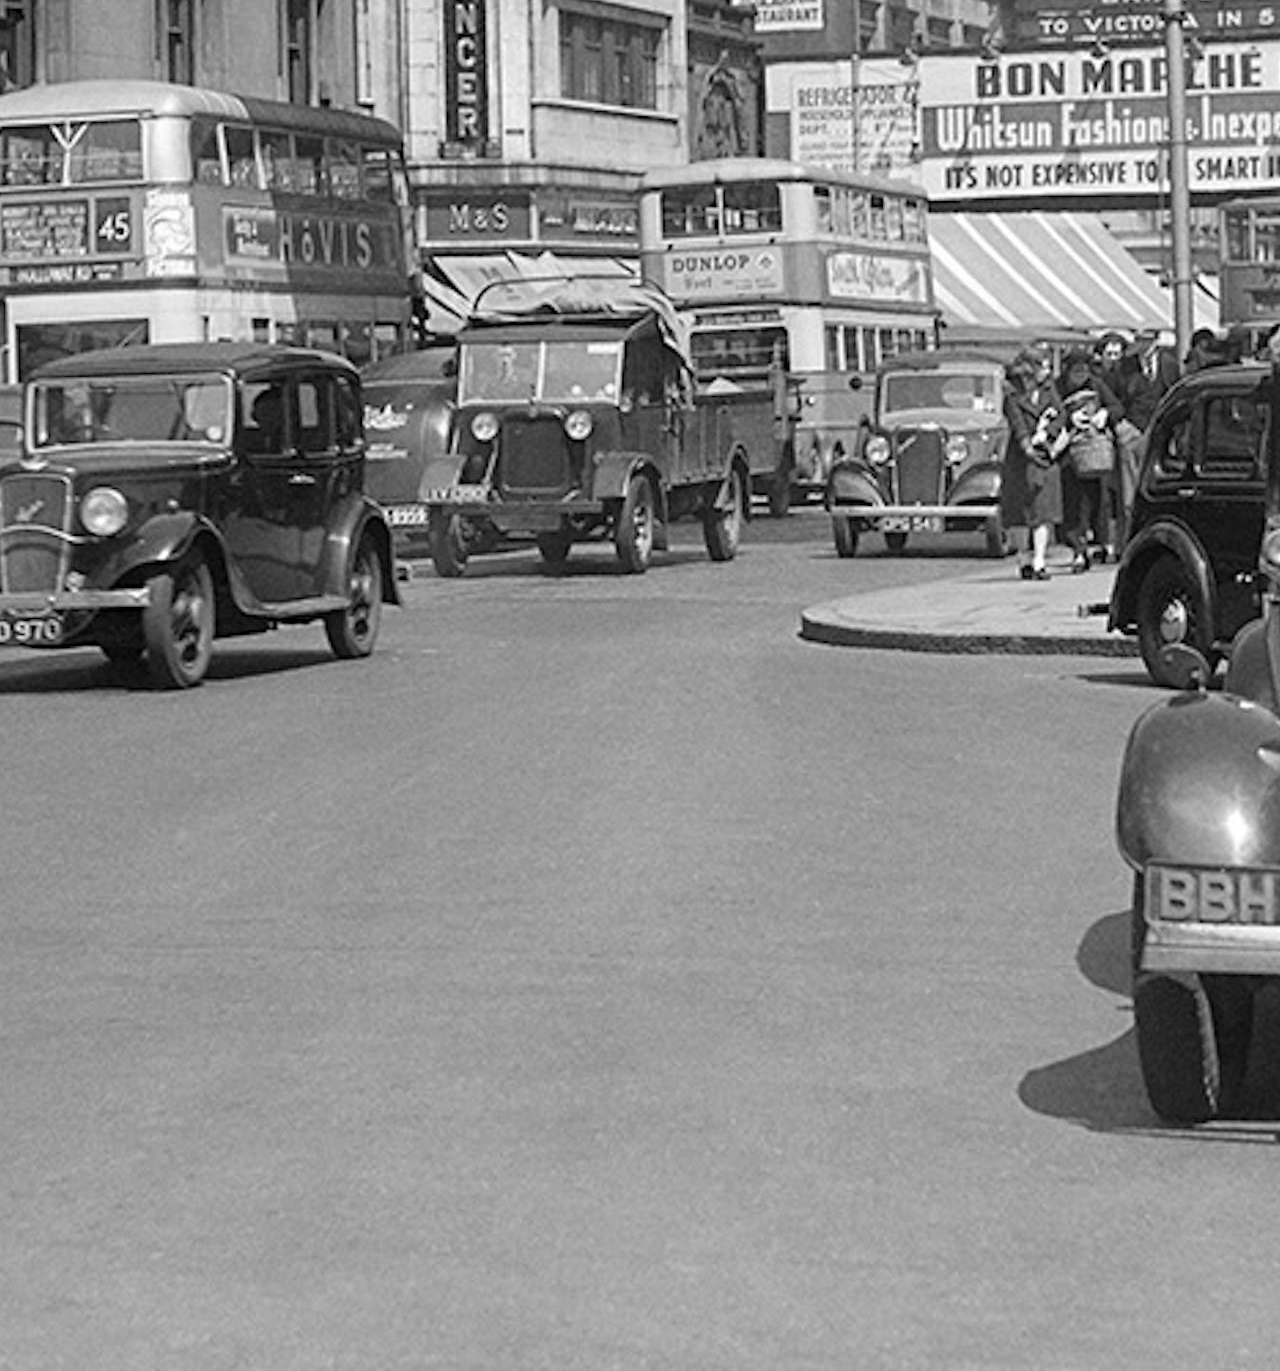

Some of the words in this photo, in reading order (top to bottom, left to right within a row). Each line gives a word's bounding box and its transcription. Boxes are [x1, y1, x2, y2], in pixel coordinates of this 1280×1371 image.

[1039, 17, 1069, 34] TO
[1083, 13, 1199, 33] VICTORA
[1217, 8, 1242, 27] IN
[976, 61, 1066, 98] BON
[936, 103, 1054, 151] Whitsun
[944, 163, 978, 189] IT'S
[985, 166, 1024, 187] NOT
[1031, 161, 1127, 186] EXPENSIVE
[1134, 159, 1159, 184] TO
[1194, 154, 1261, 181] SMART
[97, 211, 131, 242] 45
[671, 254, 751, 273] DUNLOP
[13, 618, 61, 641] 970
[1160, 869, 1275, 925] BBH
